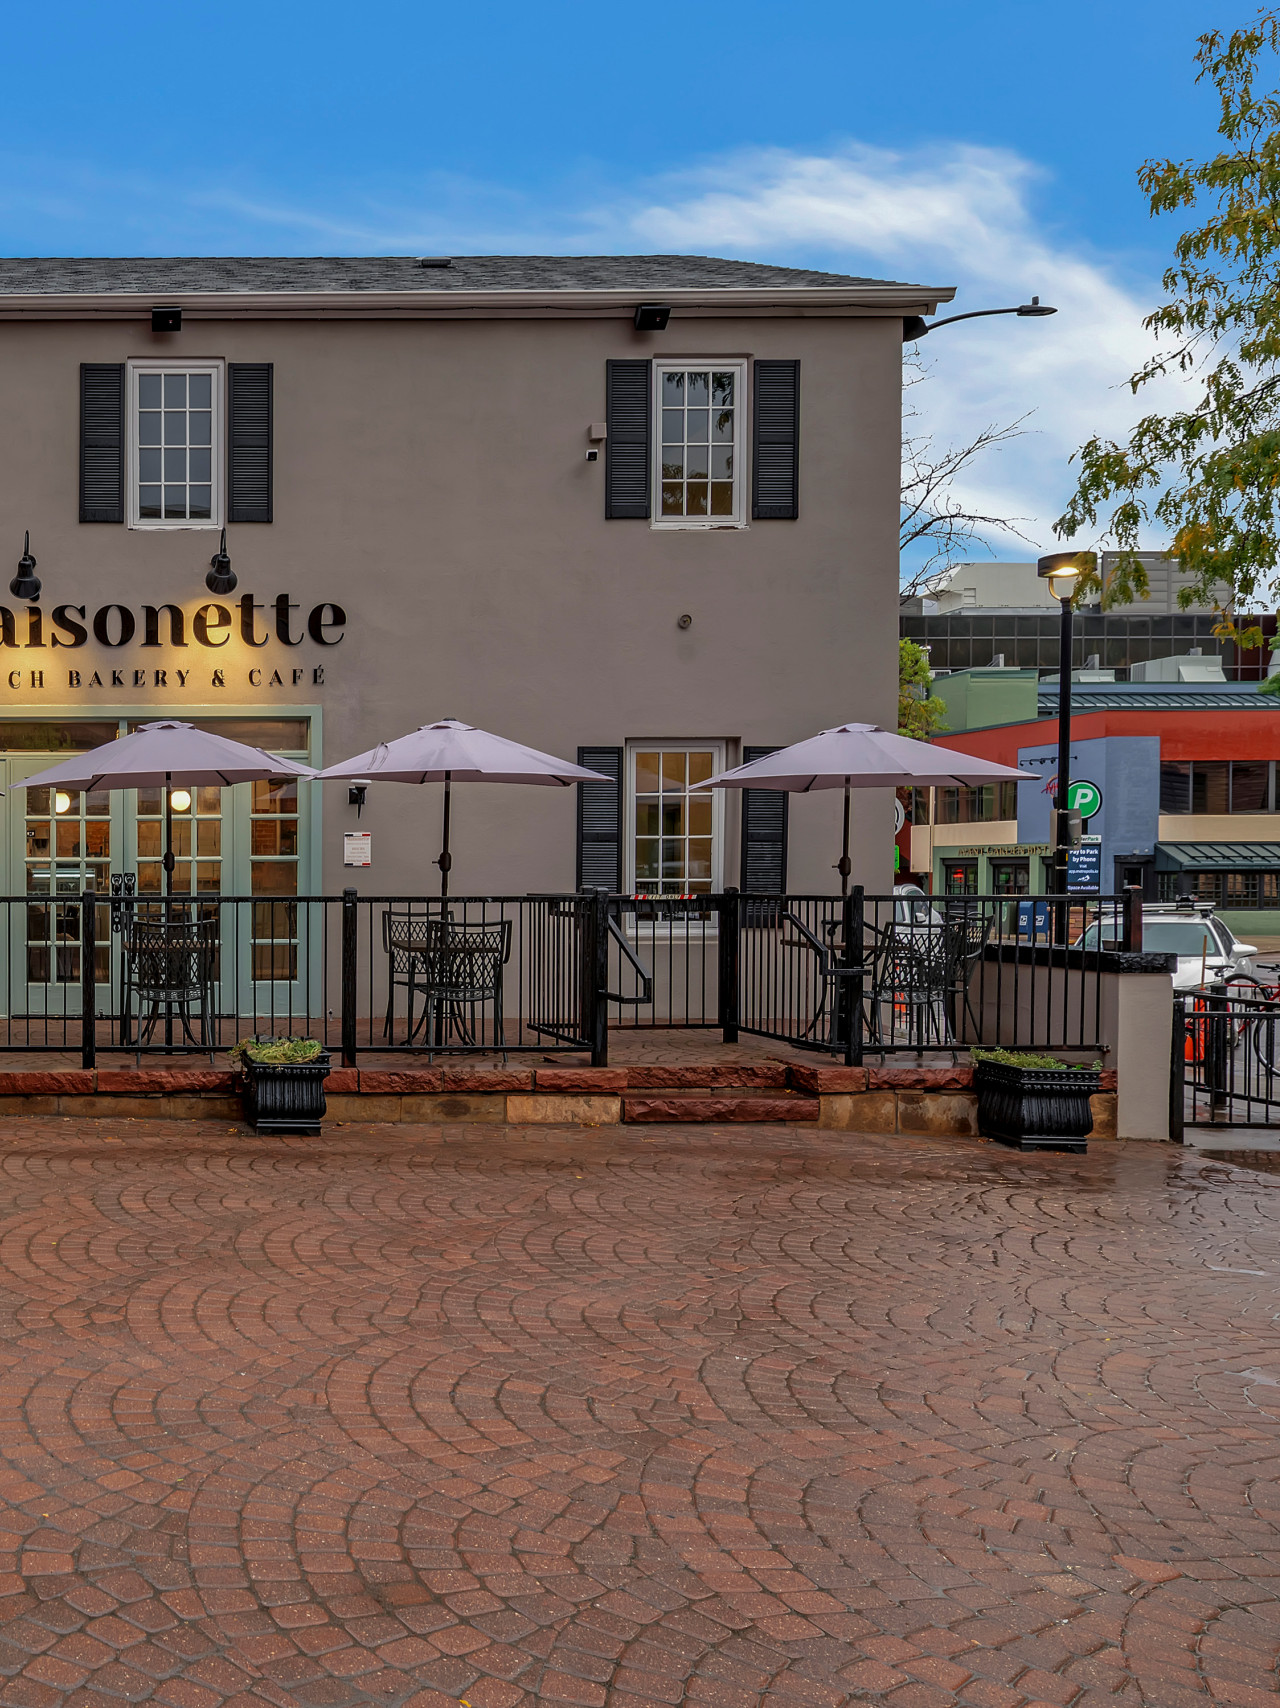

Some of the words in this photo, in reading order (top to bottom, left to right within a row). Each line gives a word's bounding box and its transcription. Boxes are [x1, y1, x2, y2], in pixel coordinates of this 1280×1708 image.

[68, 669, 191, 689] BAKERY
[211, 668, 226, 688] &
[248, 664, 326, 687] CAFÉ
[1073, 788, 1094, 809] P
